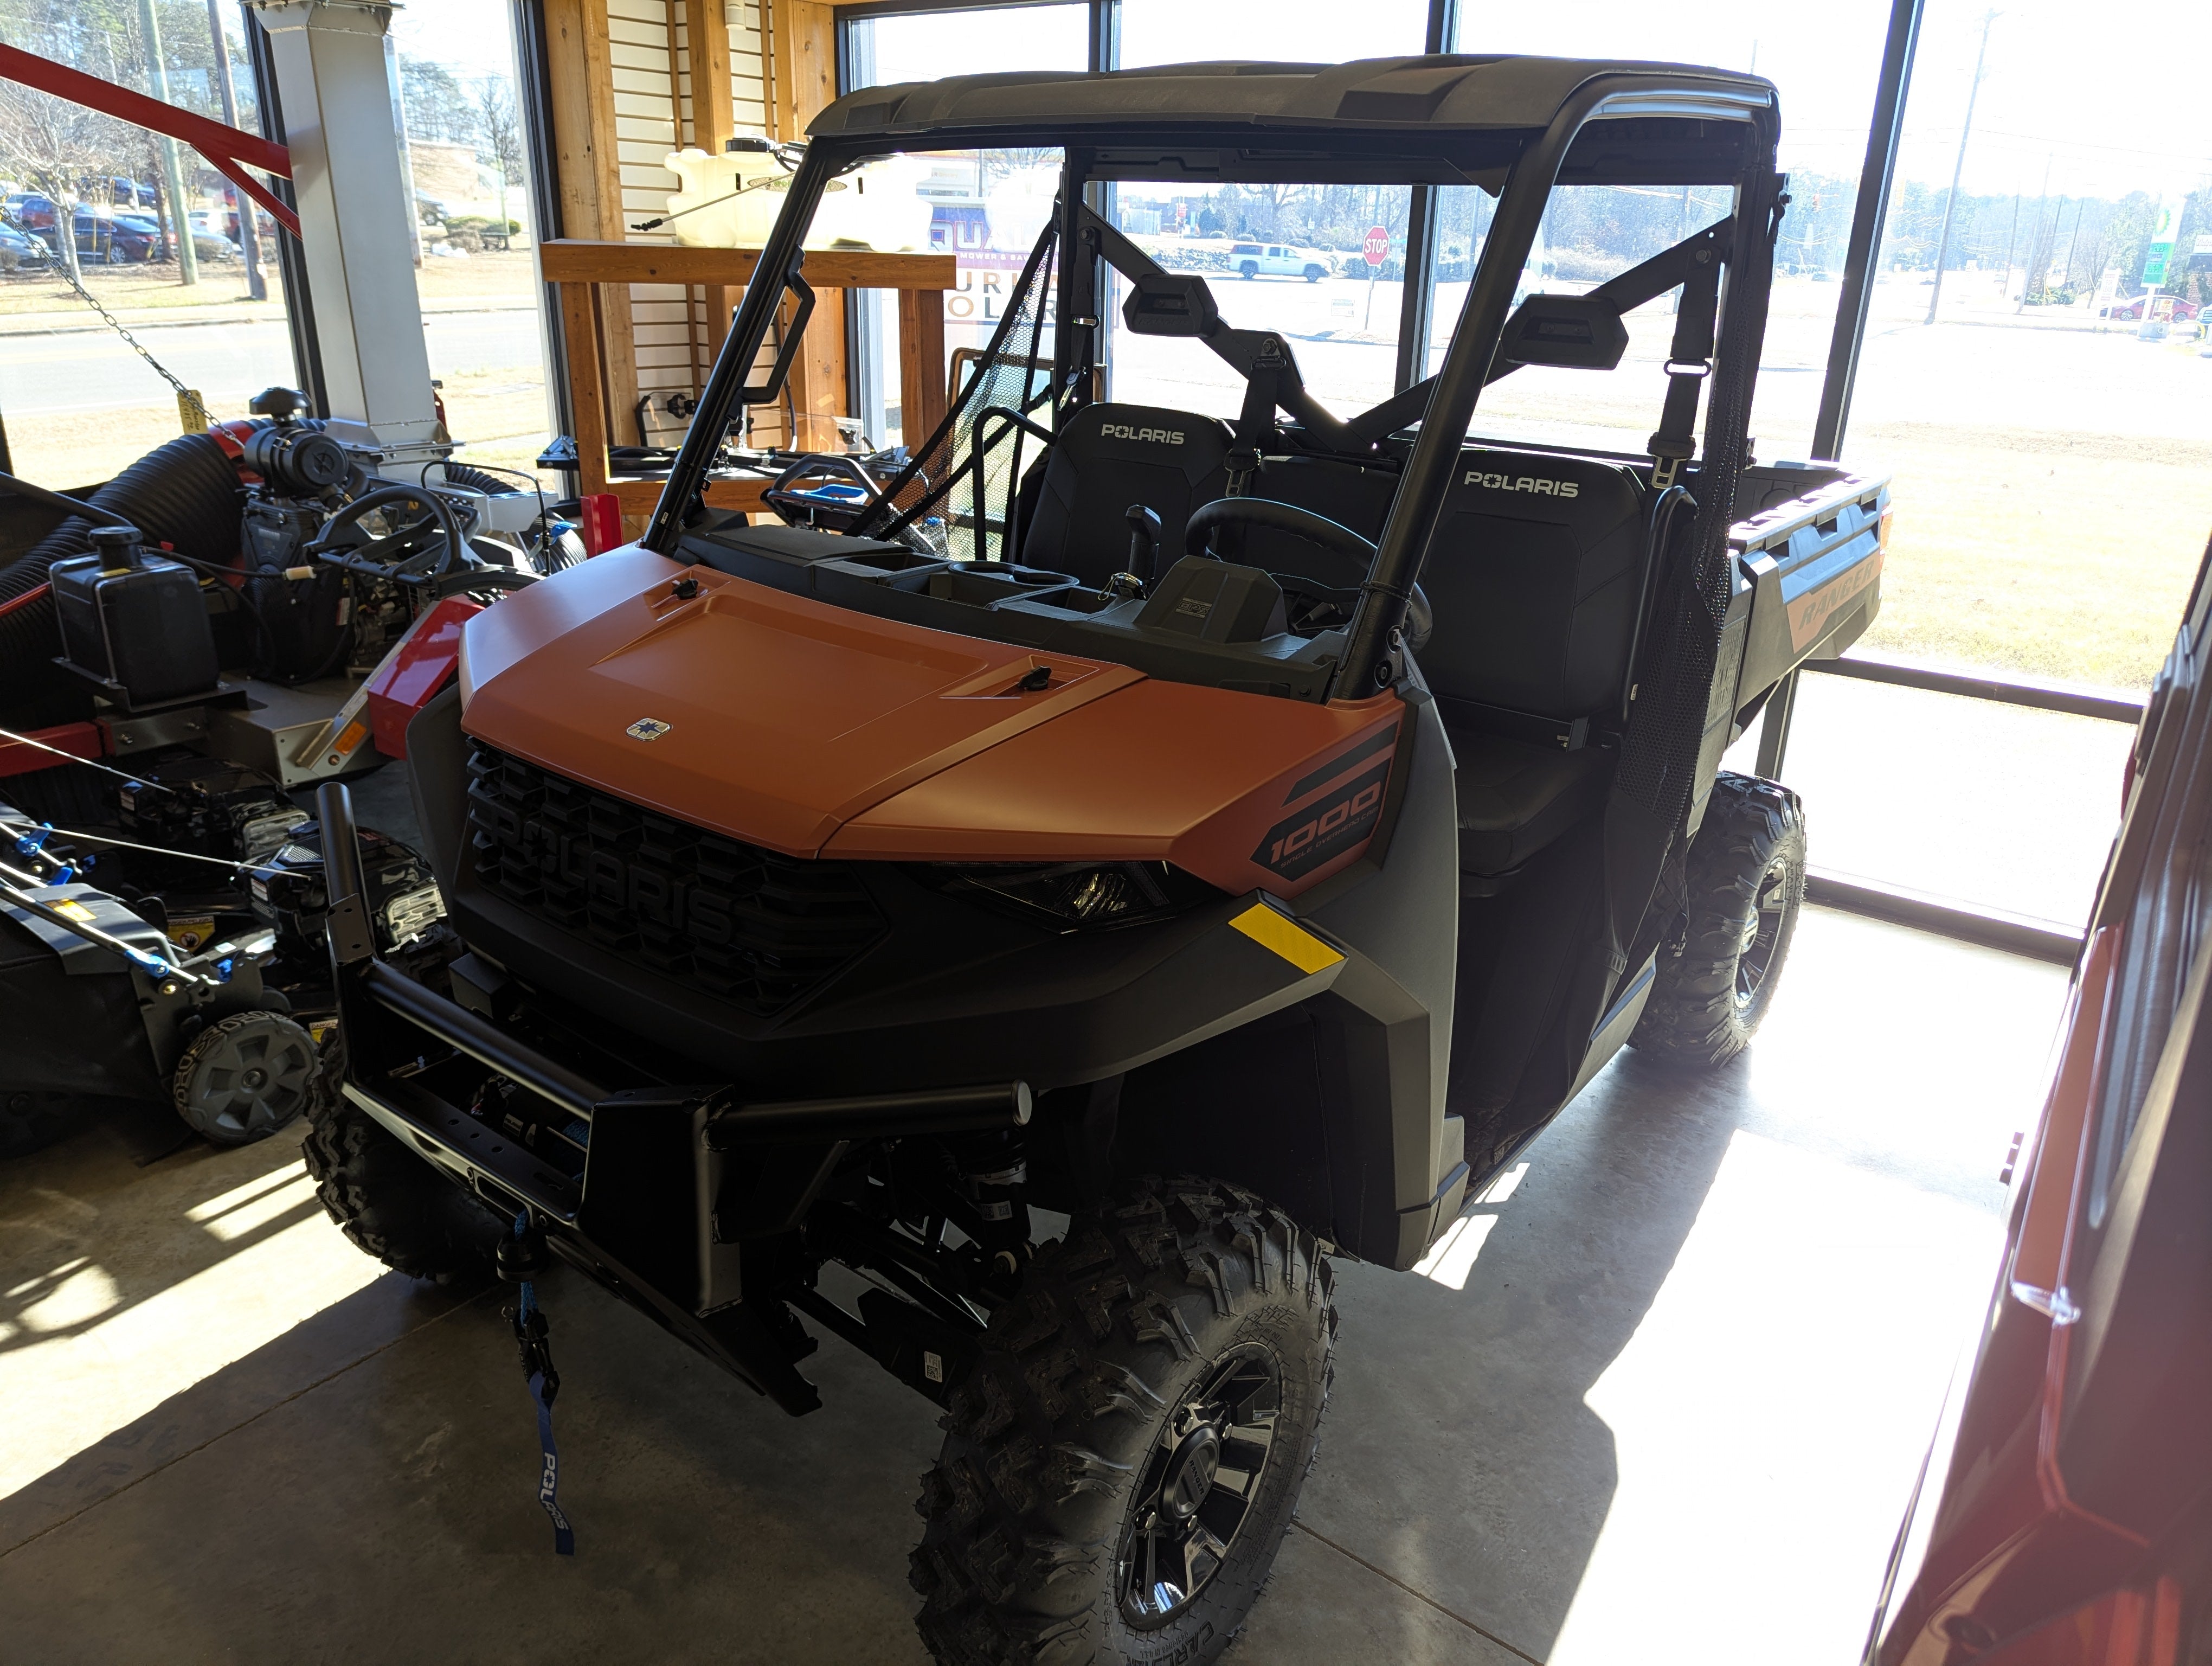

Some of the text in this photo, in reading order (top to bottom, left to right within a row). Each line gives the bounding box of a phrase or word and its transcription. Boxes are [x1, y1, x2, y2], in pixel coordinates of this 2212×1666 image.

[1365, 238, 1388, 254] STOP
[1101, 423, 1185, 445] POLARIS
[1464, 471, 1579, 498] POLARIS
[1178, 601, 1210, 615] EPS
[1798, 559, 1874, 631] RANGER
[1270, 781, 1381, 864] 1000
[1281, 806, 1379, 868] SINGLE OVERHEAD CAM
[492, 805, 734, 945] POLARIS
[540, 1452, 569, 1530] POLARIS
[1189, 1459, 1204, 1495] RANGER
